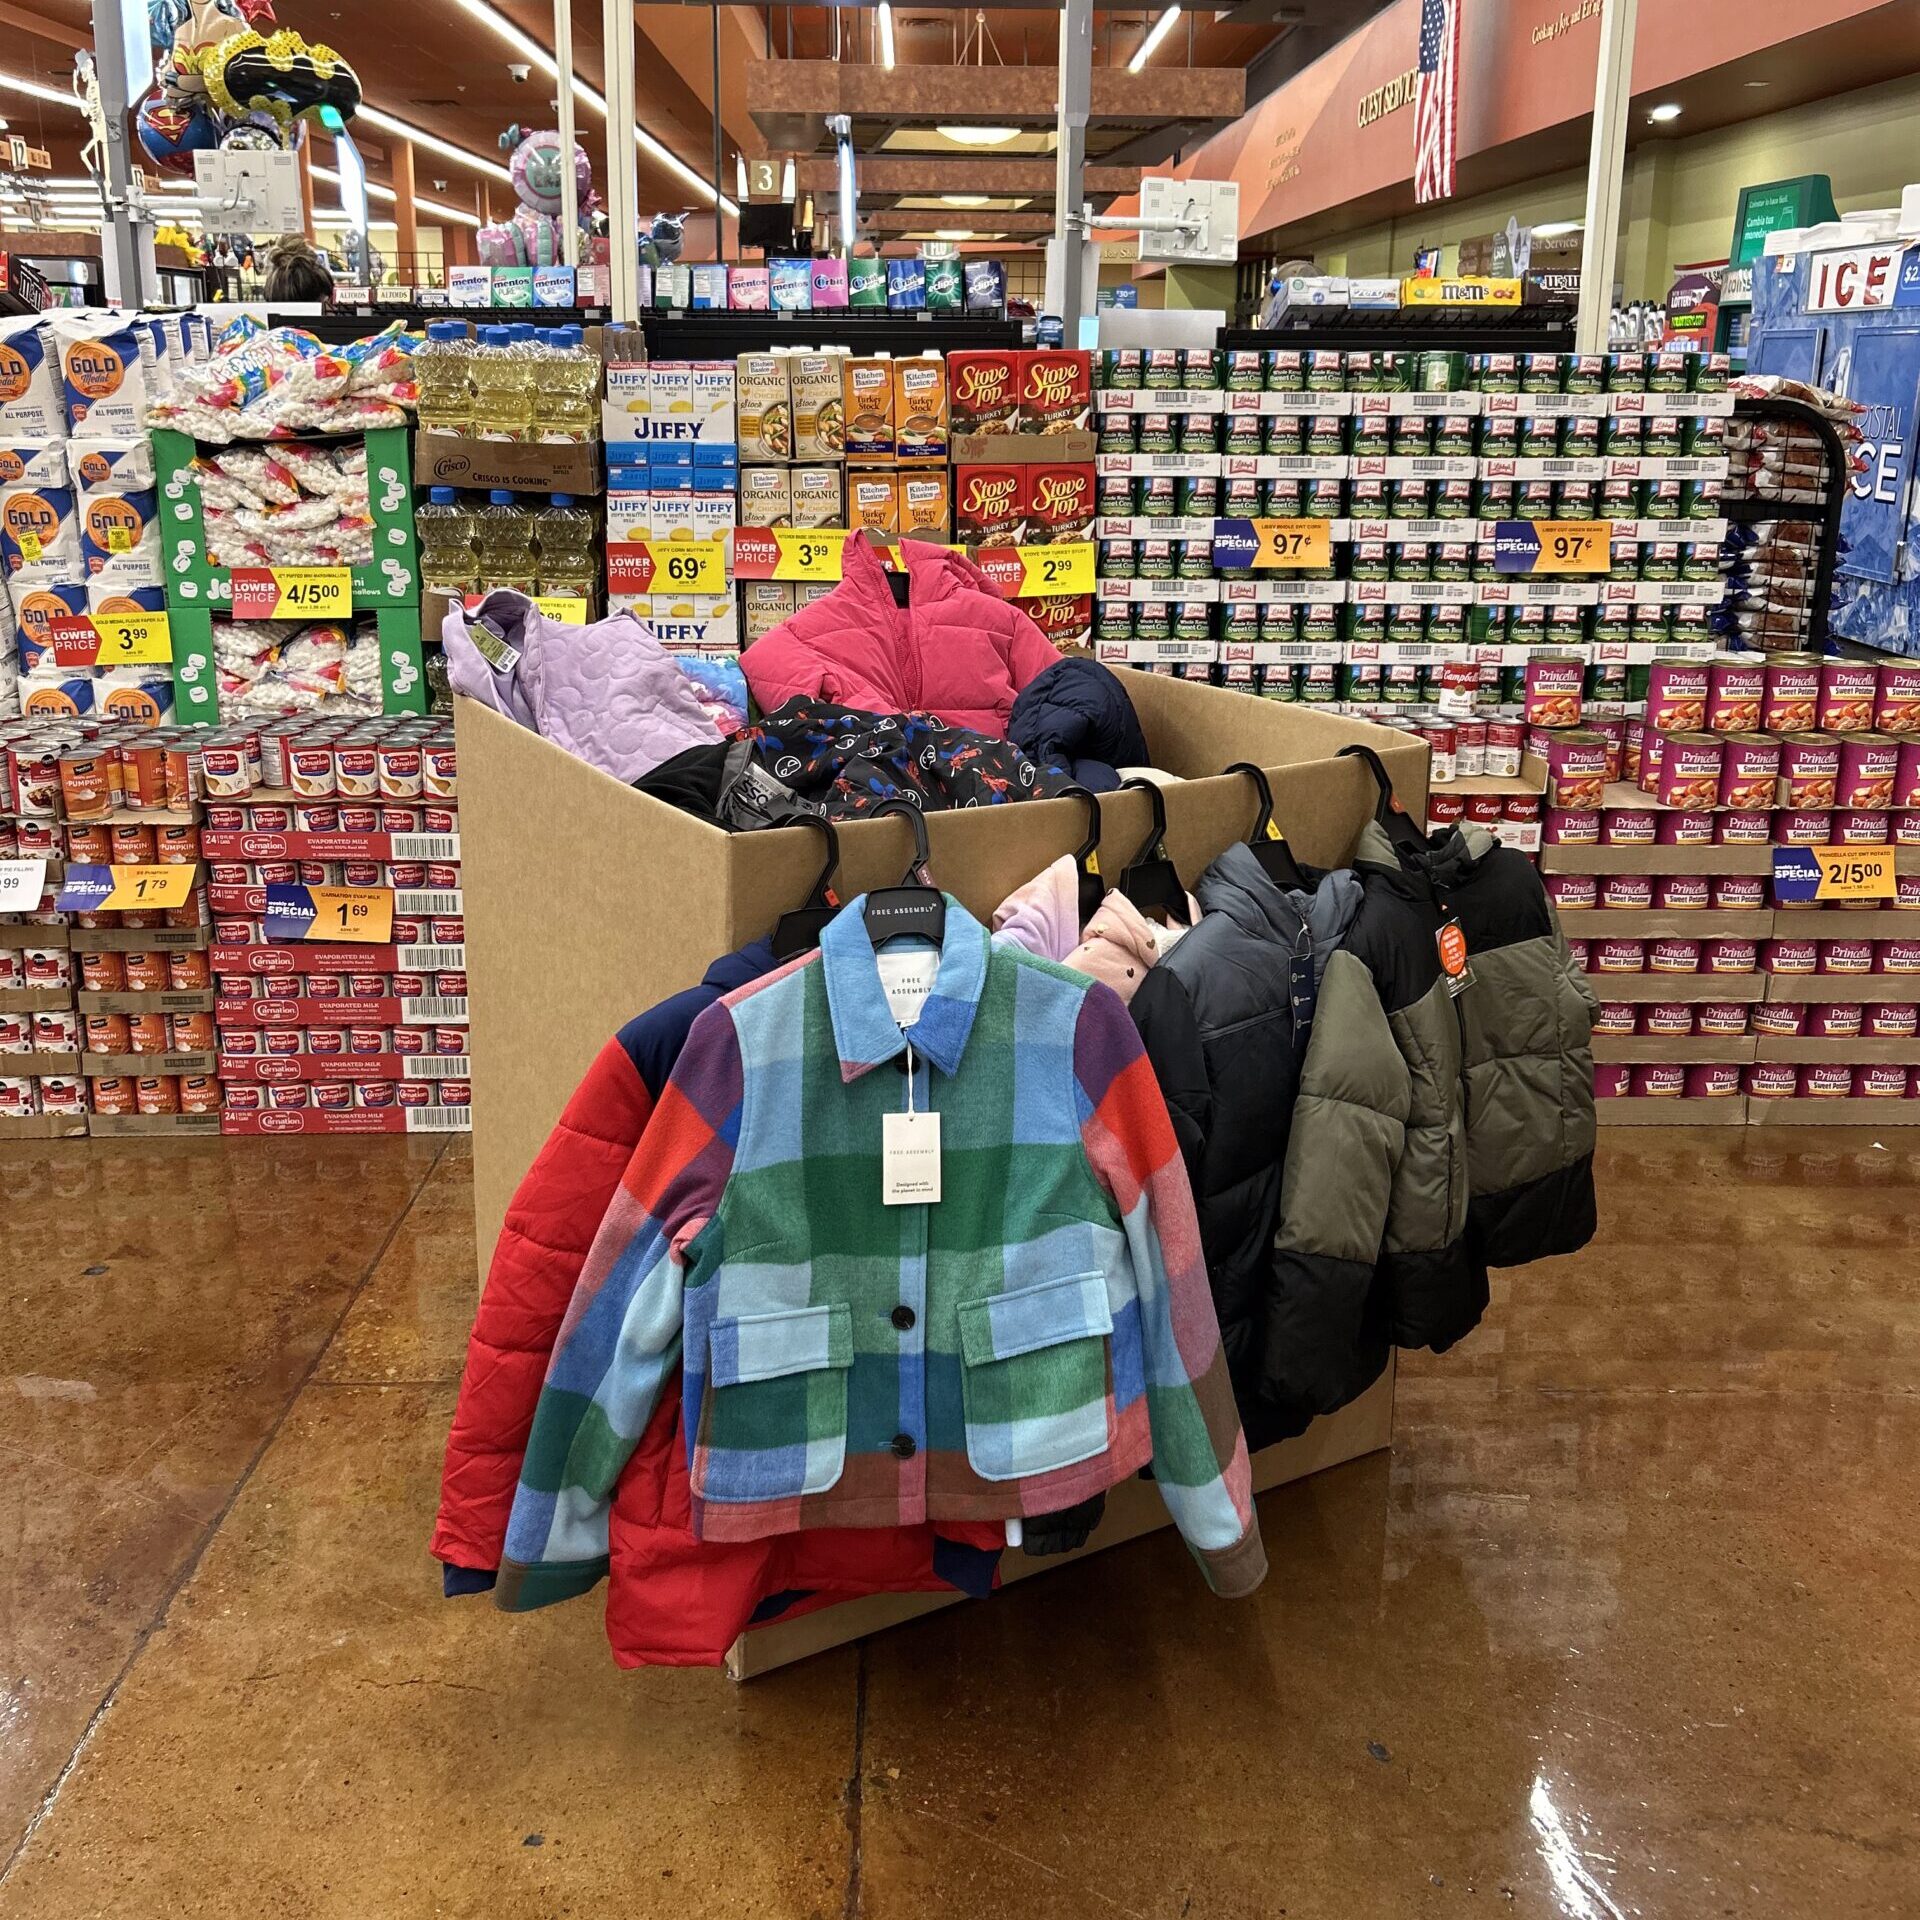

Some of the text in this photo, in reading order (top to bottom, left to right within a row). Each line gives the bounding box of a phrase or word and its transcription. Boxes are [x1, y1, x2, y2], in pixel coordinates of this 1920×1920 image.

[758, 165, 773, 191] 3
[452, 276, 488, 286] mentos
[494, 278, 530, 288] mentos
[535, 278, 571, 288] mentos
[928, 277, 959, 293] eclipse
[968, 277, 999, 294] eclipse
[1817, 254, 1891, 309] ICE
[339, 291, 366, 299] ALTOIDS
[380, 290, 408, 299] ALTOIDS
[71, 357, 116, 373] GOLD
[609, 373, 647, 384] JIFFY
[652, 373, 689, 385] JIFFY
[695, 374, 732, 385] JIFFY
[739, 377, 785, 386] ORGANIC
[793, 375, 838, 385] ORGANIC
[956, 366, 1009, 400] Stove
[1024, 364, 1079, 398] Stove
[974, 386, 1002, 407] Top
[1043, 384, 1072, 407] Top
[976, 410, 1001, 422] TURKEY
[1044, 409, 1070, 421] TURKEY
[83, 462, 106, 470] GOLD
[437, 458, 467, 476] Crisco
[743, 491, 789, 499] ORGANIC
[963, 478, 1017, 512] Stove
[982, 499, 1009, 520] Top
[983, 521, 1009, 534] TURKEY
[736, 544, 777, 553] LOWER
[1214, 540, 1259, 548] SPECIAL
[1496, 543, 1541, 551] SPECIAL
[610, 558, 650, 567] LOWER
[736, 553, 776, 563] PRICE
[609, 567, 650, 578] PRICE
[982, 563, 1021, 573] LOWER
[234, 583, 275, 592] LOWER
[234, 592, 275, 603] PRICE
[54, 630, 96, 640] LOWER
[55, 640, 97, 651] PRICE
[1539, 669, 1577, 681] Princella
[68, 778, 103, 787] PUMPKIN
[205, 835, 216, 843] 24
[1775, 869, 1821, 879] SPECIAL
[64, 884, 114, 893] SPECIAL
[267, 906, 316, 917] SPECIAL
[214, 952, 225, 960] 24
[892, 987, 931, 995] ASSEMBLY
